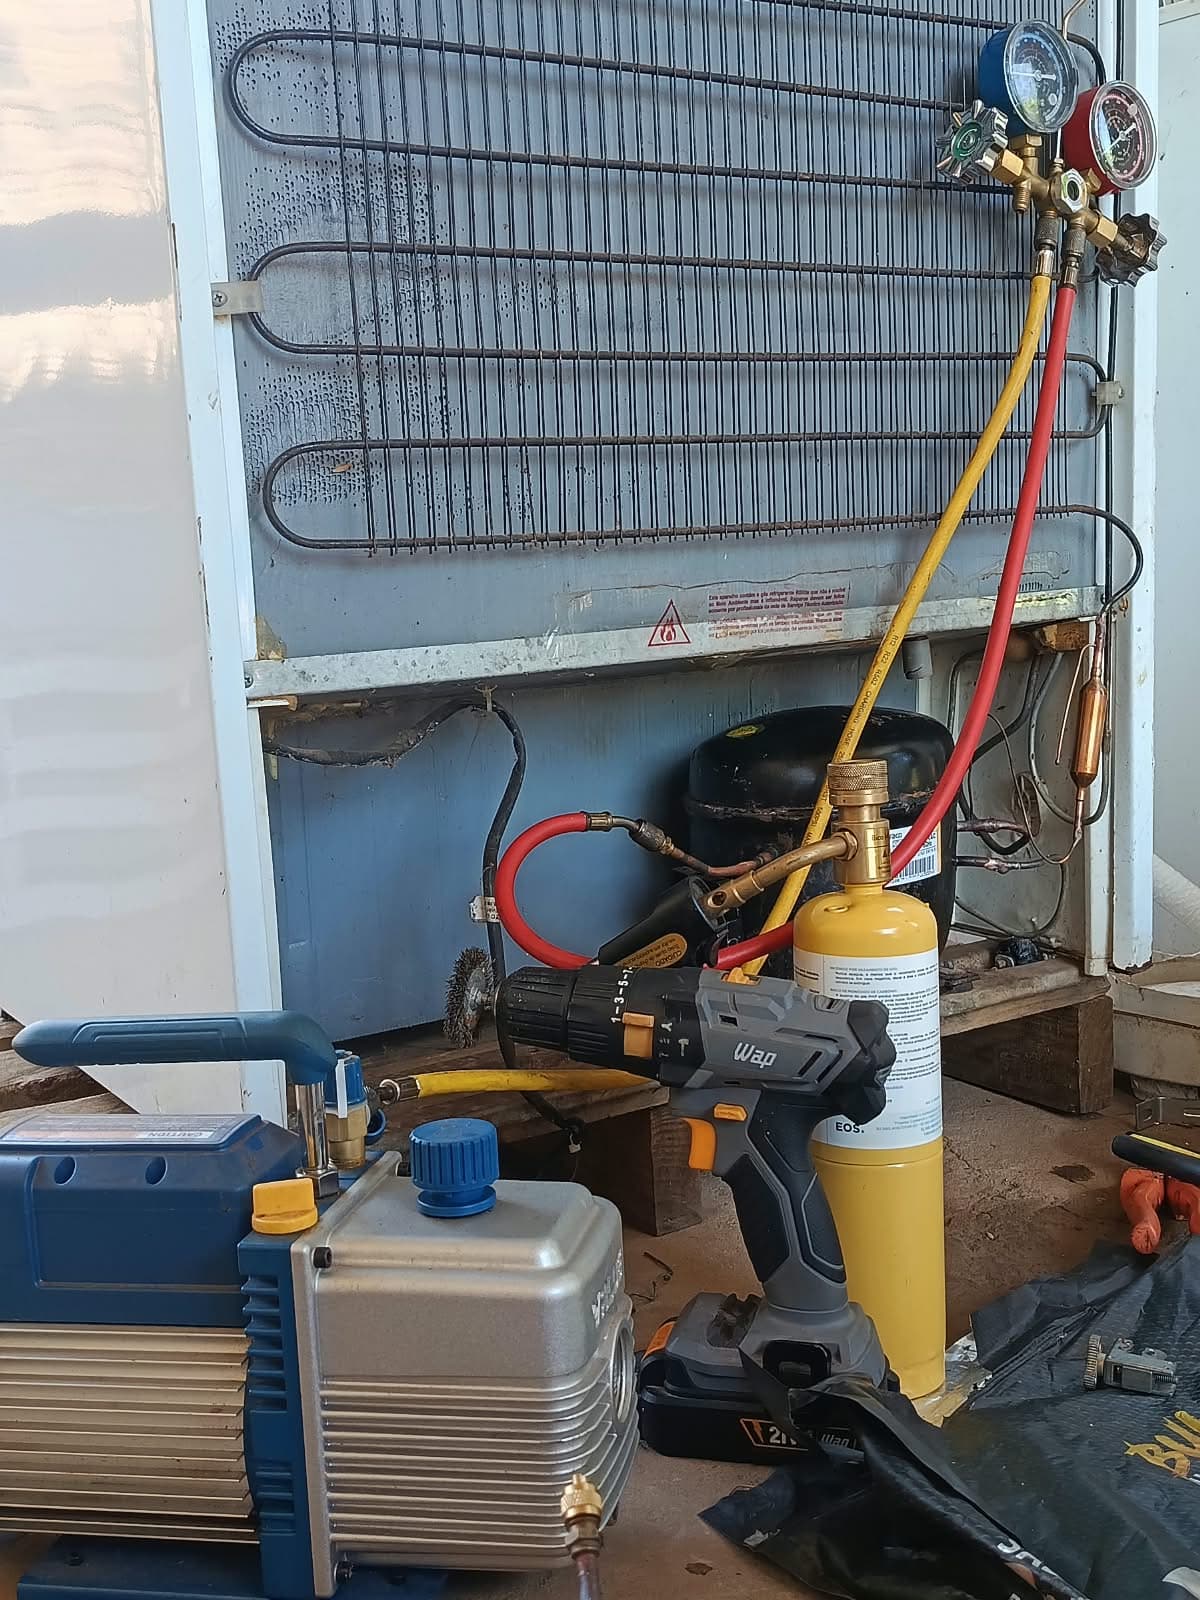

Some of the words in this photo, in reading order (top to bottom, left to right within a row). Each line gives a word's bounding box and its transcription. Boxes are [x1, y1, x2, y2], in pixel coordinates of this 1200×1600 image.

[881, 650, 891, 664] R22
[853, 690, 872, 724] CHARGING
[844, 728, 856, 746] HOSE
[655, 950, 682, 967] CUIDADO
[734, 1042, 777, 1068] Wap
